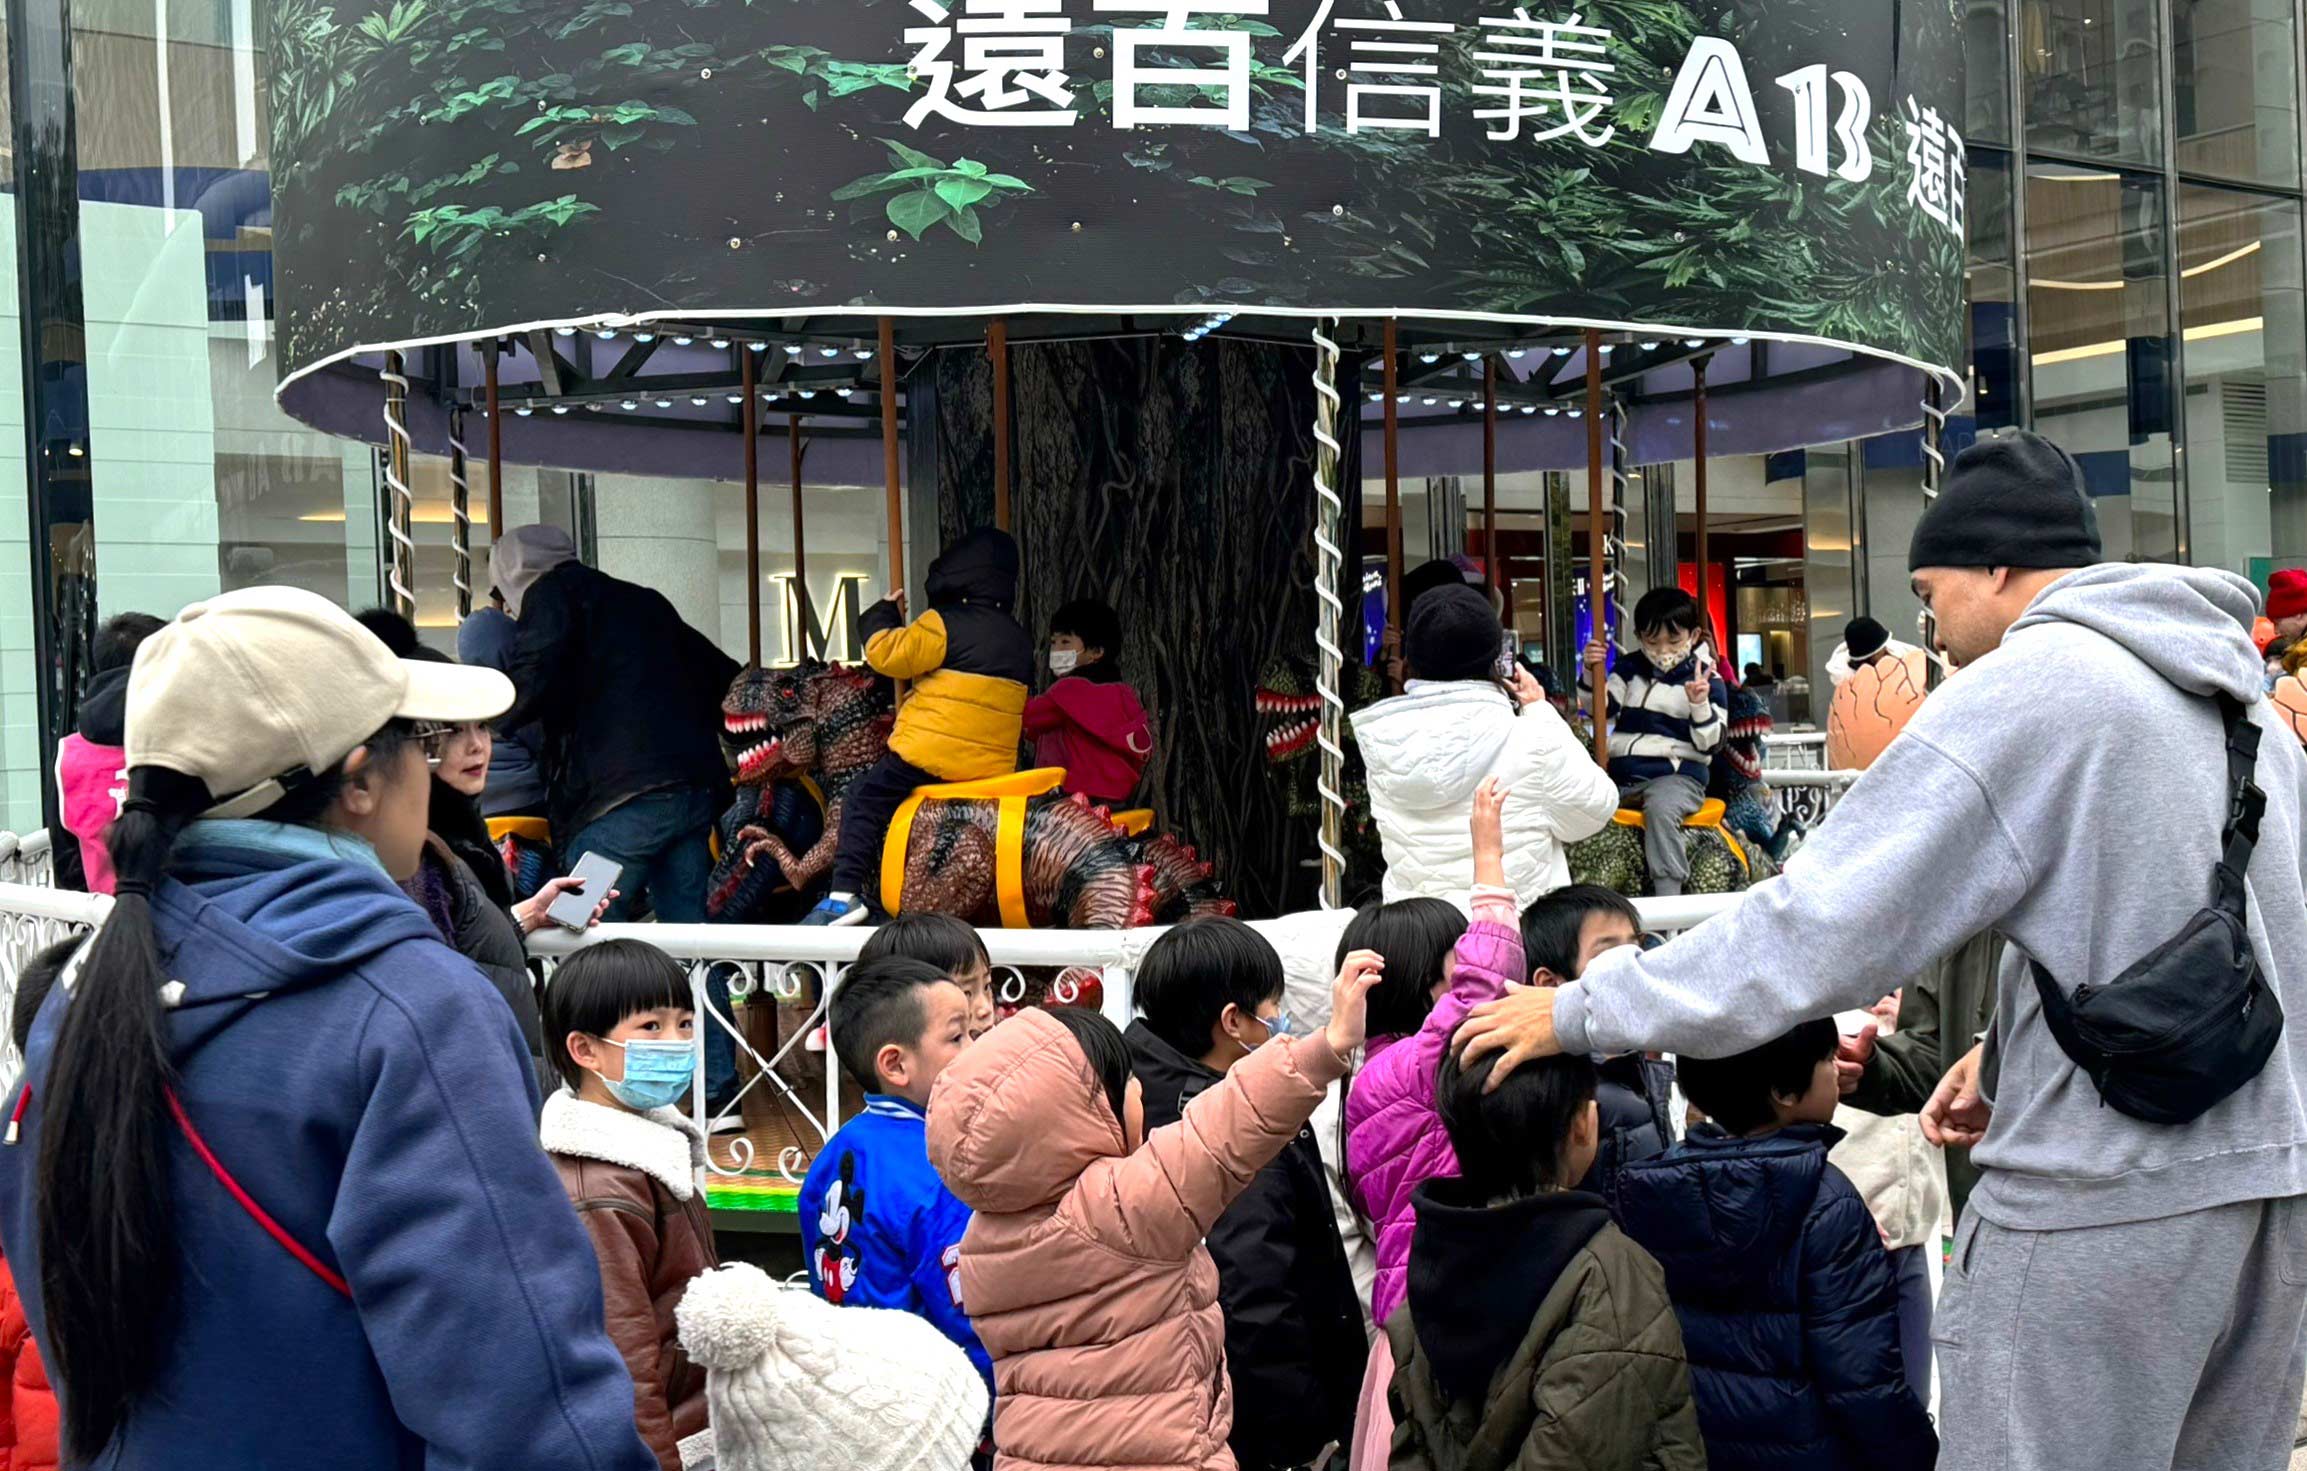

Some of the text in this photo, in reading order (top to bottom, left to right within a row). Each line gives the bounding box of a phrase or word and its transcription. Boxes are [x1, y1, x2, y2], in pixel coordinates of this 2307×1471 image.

[902, 0, 1616, 147] 遠百信義
[767, 571, 871, 668] M
